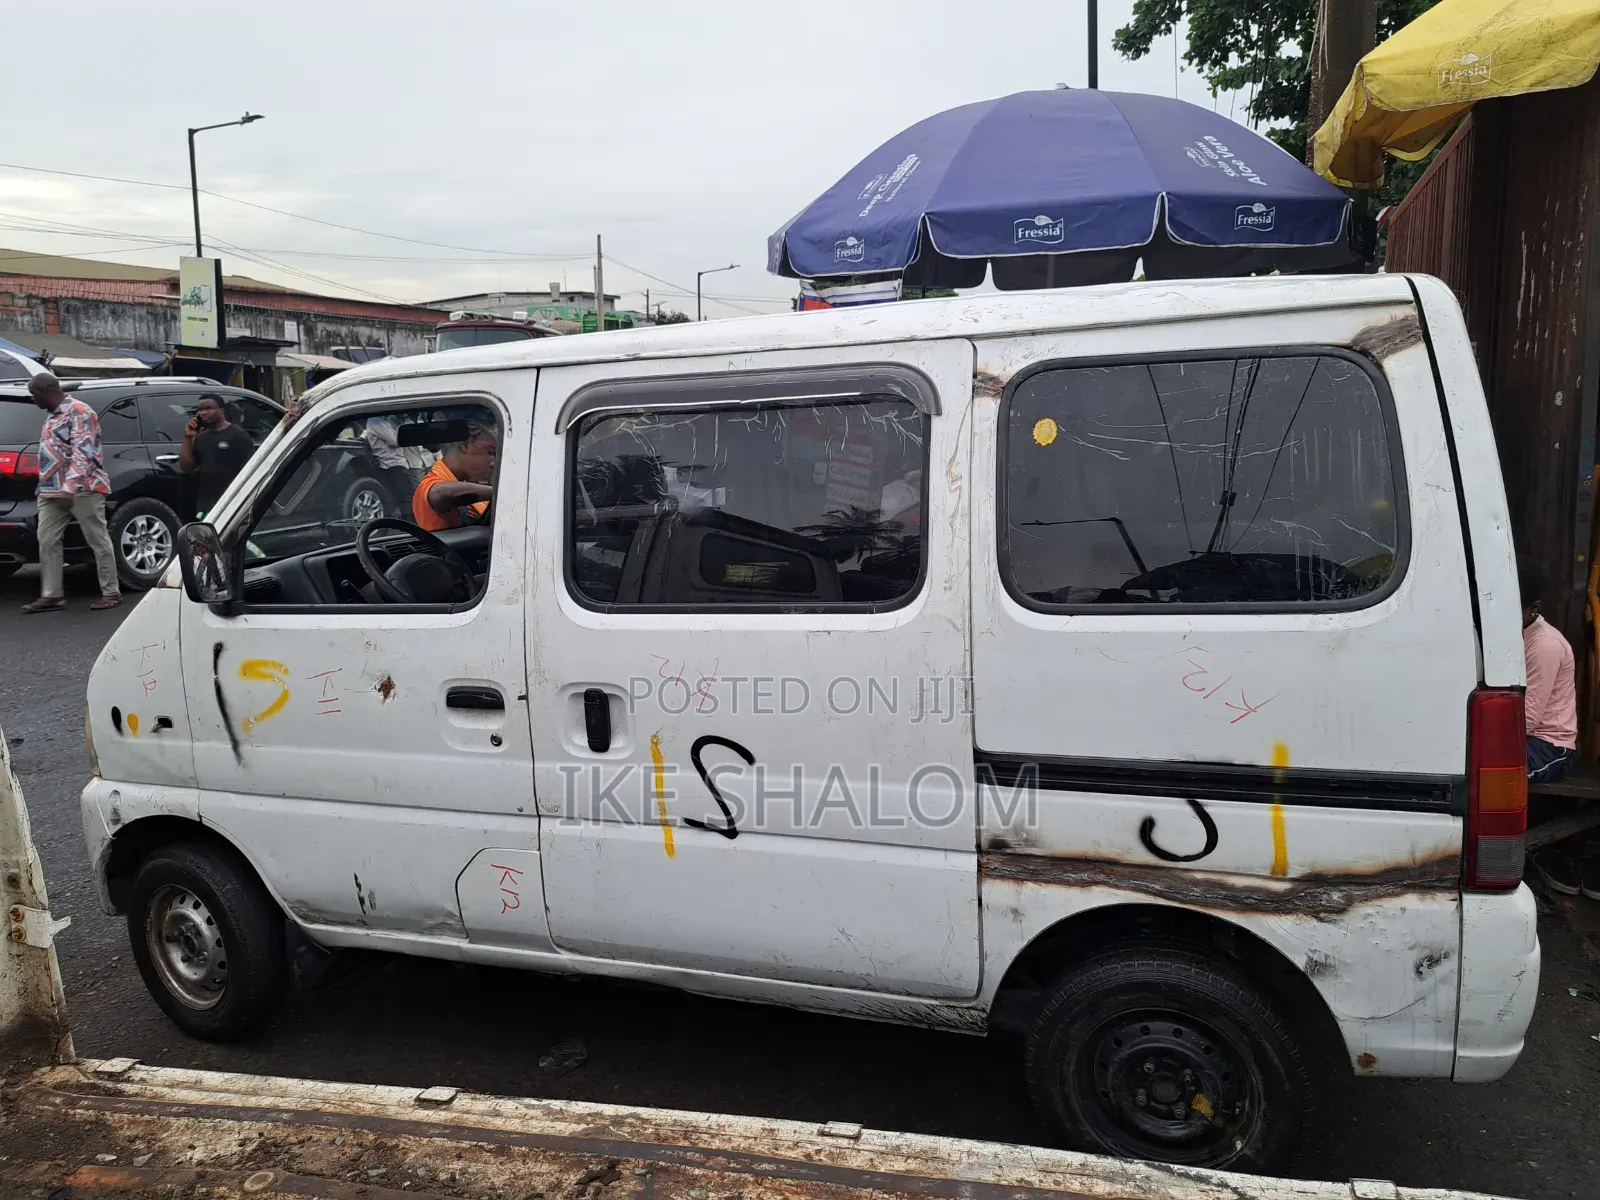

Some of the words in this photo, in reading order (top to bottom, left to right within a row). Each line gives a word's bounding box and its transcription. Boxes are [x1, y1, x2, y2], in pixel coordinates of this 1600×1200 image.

[1194, 141, 1219, 160] Glow
[1203, 136, 1235, 158] Vera
[1217, 160, 1240, 177] Skin
[1231, 159, 1268, 186] Aloe
[858, 193, 883, 217] Deep
[1237, 212, 1272, 225] Fressia
[1018, 225, 1061, 239] Fressia
[490, 863, 524, 915] K12
